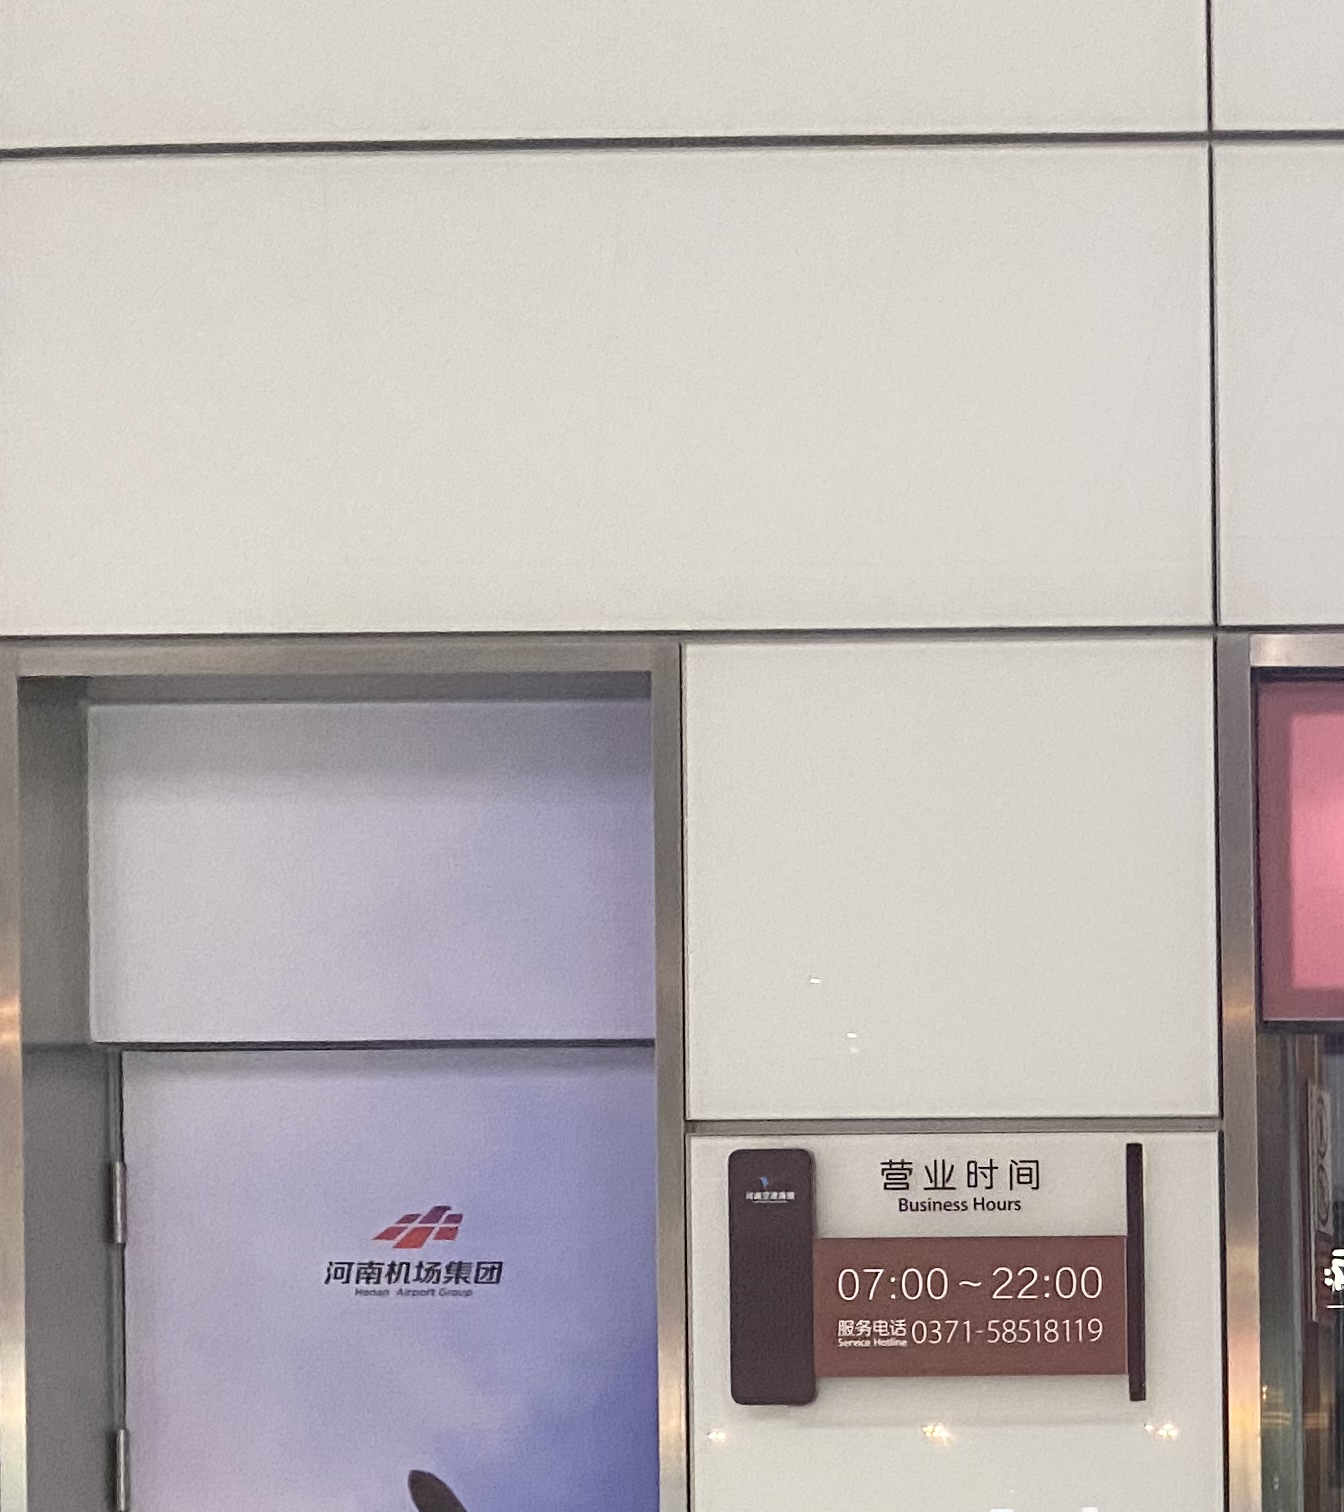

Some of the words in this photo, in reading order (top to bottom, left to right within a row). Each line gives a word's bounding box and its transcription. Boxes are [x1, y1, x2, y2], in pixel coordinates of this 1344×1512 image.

[880, 1158, 1041, 1191] 营业时间
[898, 1197, 968, 1212] Business
[973, 1197, 1022, 1212] Hours
[324, 1260, 504, 1285] 河南机场集团
[837, 1267, 949, 1301] 07:00
[991, 1266, 1103, 1299] 22:00
[354, 1288, 390, 1297] Henan
[395, 1288, 435, 1298] Airport
[438, 1288, 473, 1298] Group
[837, 1319, 907, 1337] 服务电话
[911, 1318, 1103, 1344] 0371-58518119
[837, 1338, 871, 1347] Service
[873, 1338, 907, 1348] Hotline
